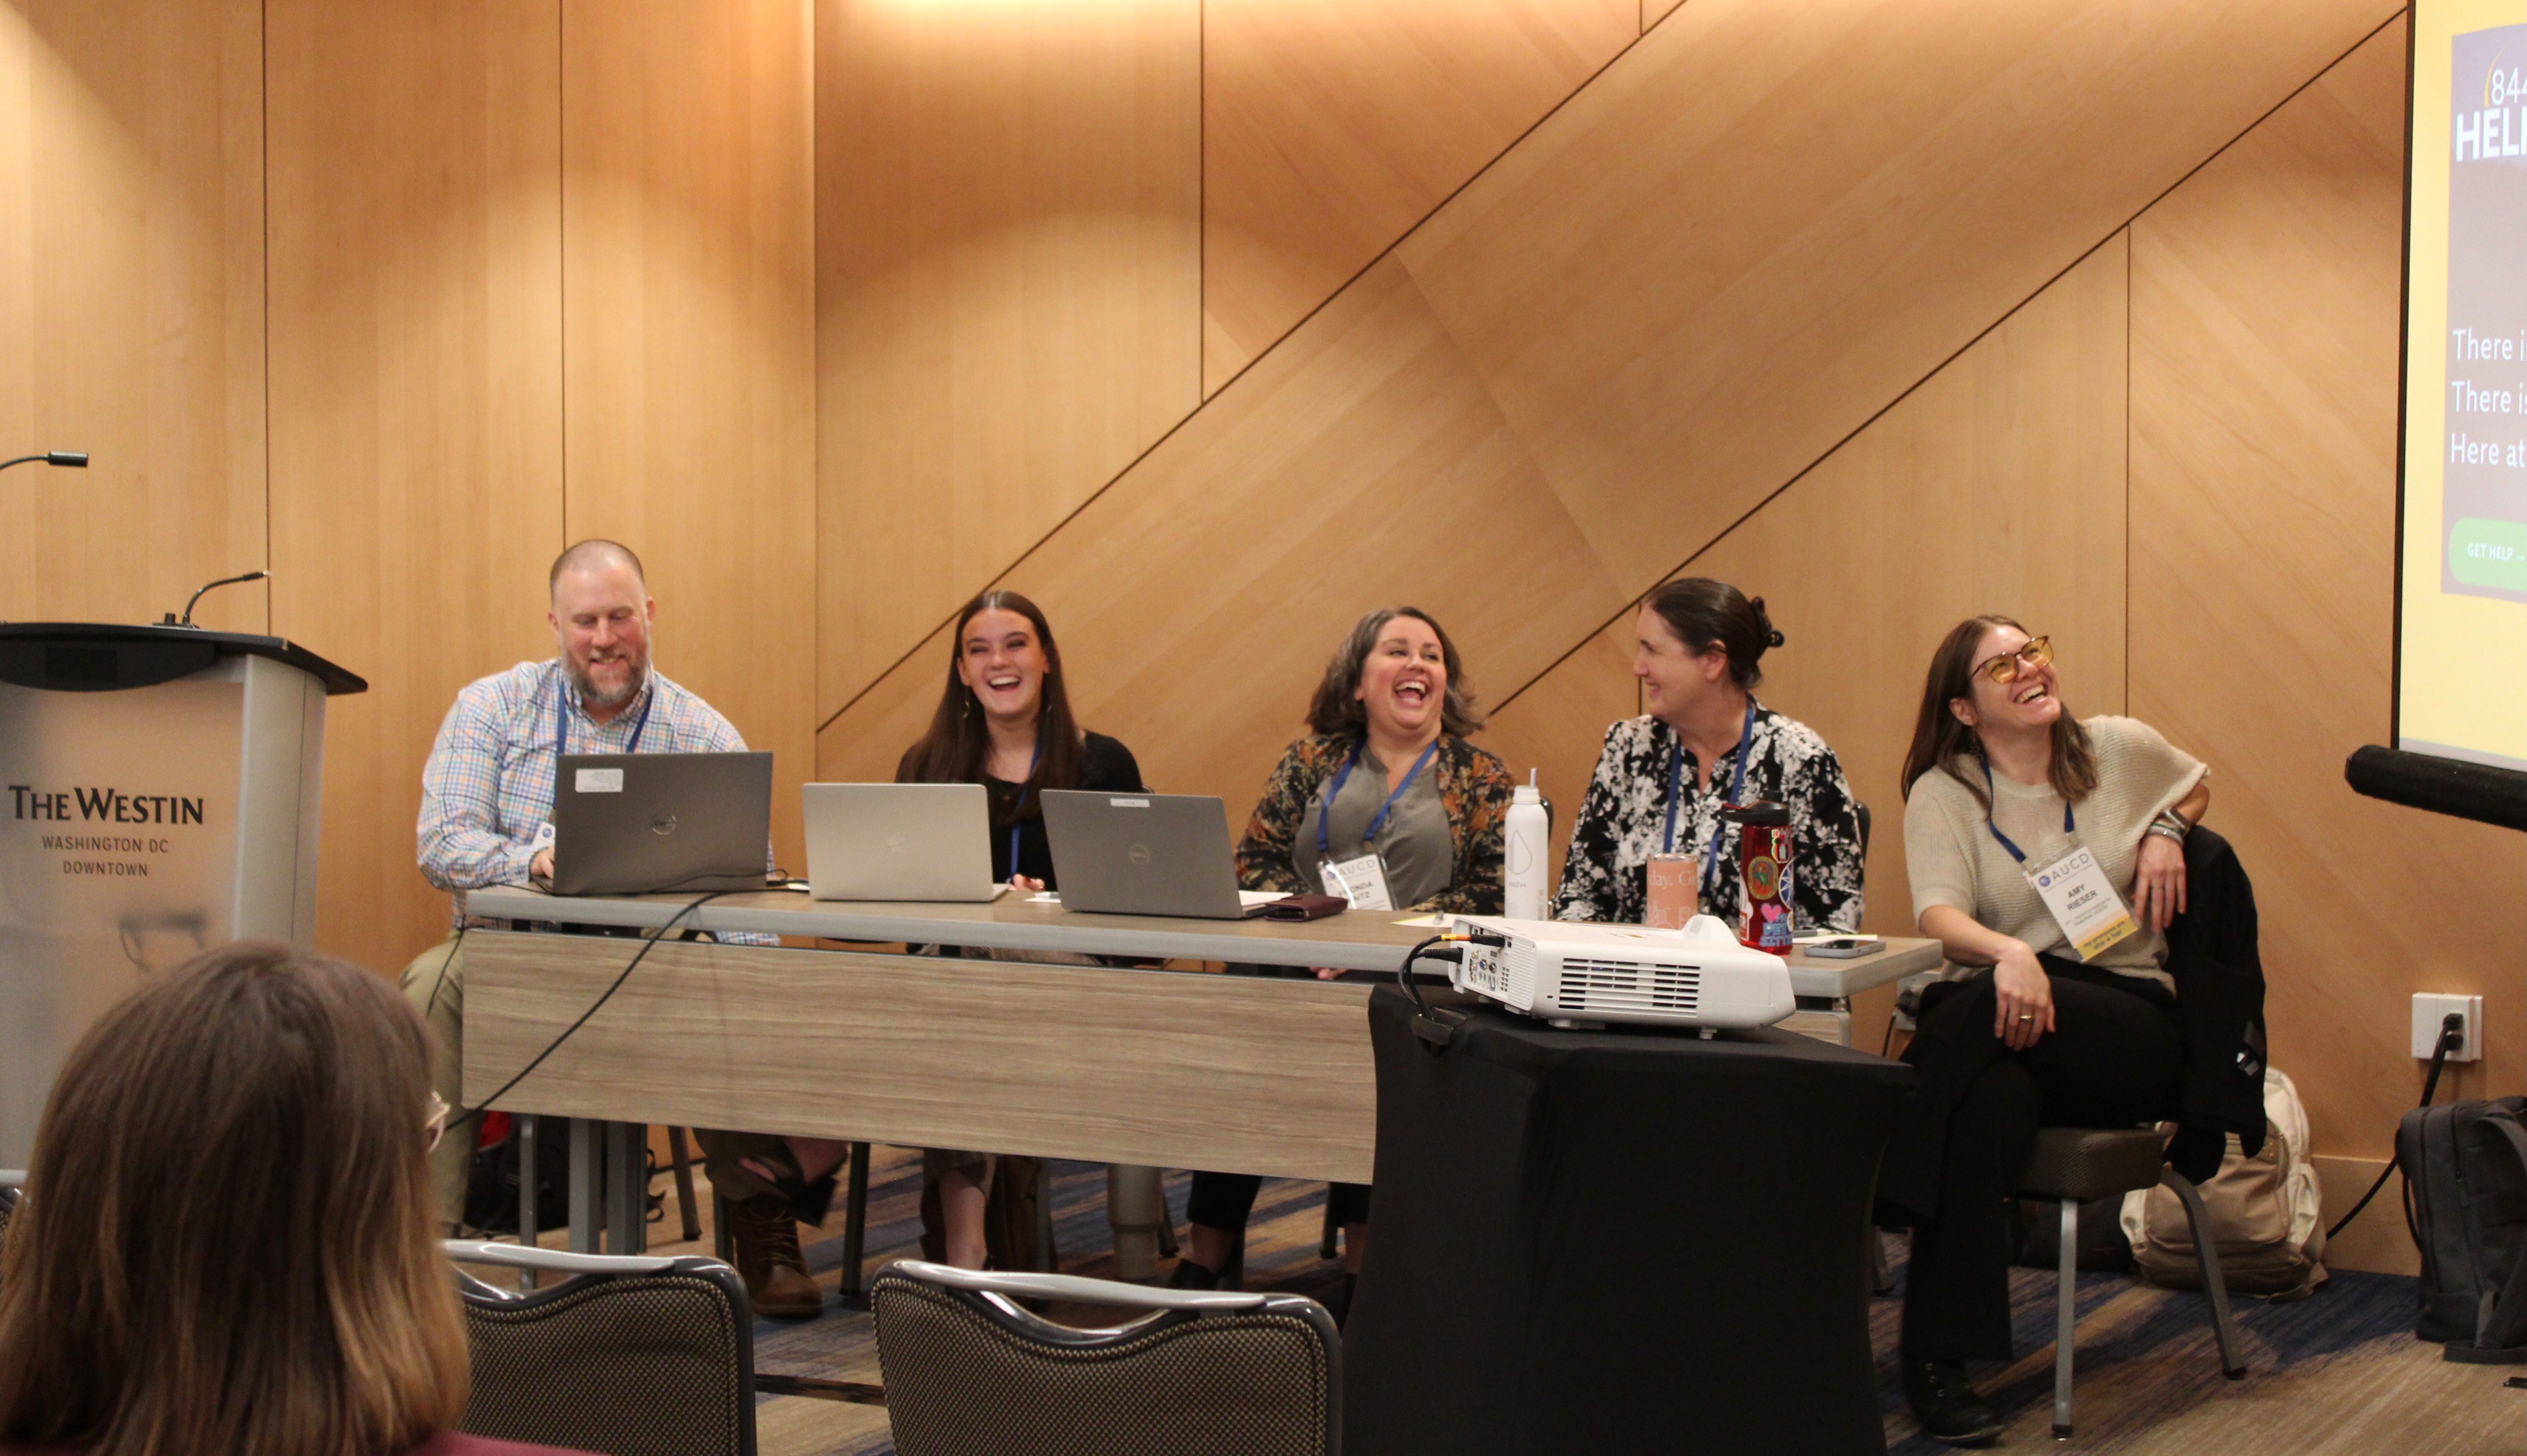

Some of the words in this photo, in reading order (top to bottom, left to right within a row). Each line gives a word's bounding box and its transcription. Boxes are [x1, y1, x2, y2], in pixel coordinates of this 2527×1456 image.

[2452, 327, 2513, 360] There
[2451, 379, 2512, 414] There
[2451, 431, 2500, 465] Here
[2506, 439, 2526, 468] at
[2467, 542, 2487, 558] GET
[2489, 545, 2514, 562] HELP
[8, 785, 71, 821] THE
[74, 787, 204, 825] WESTIN
[42, 836, 142, 852] WASHINGTON
[149, 839, 168, 853] DC
[63, 861, 148, 877] DOWNTOWN
[2052, 853, 2089, 881] AUCD
[2067, 890, 2098, 911] RIESER
[2068, 884, 2085, 899] AMY
